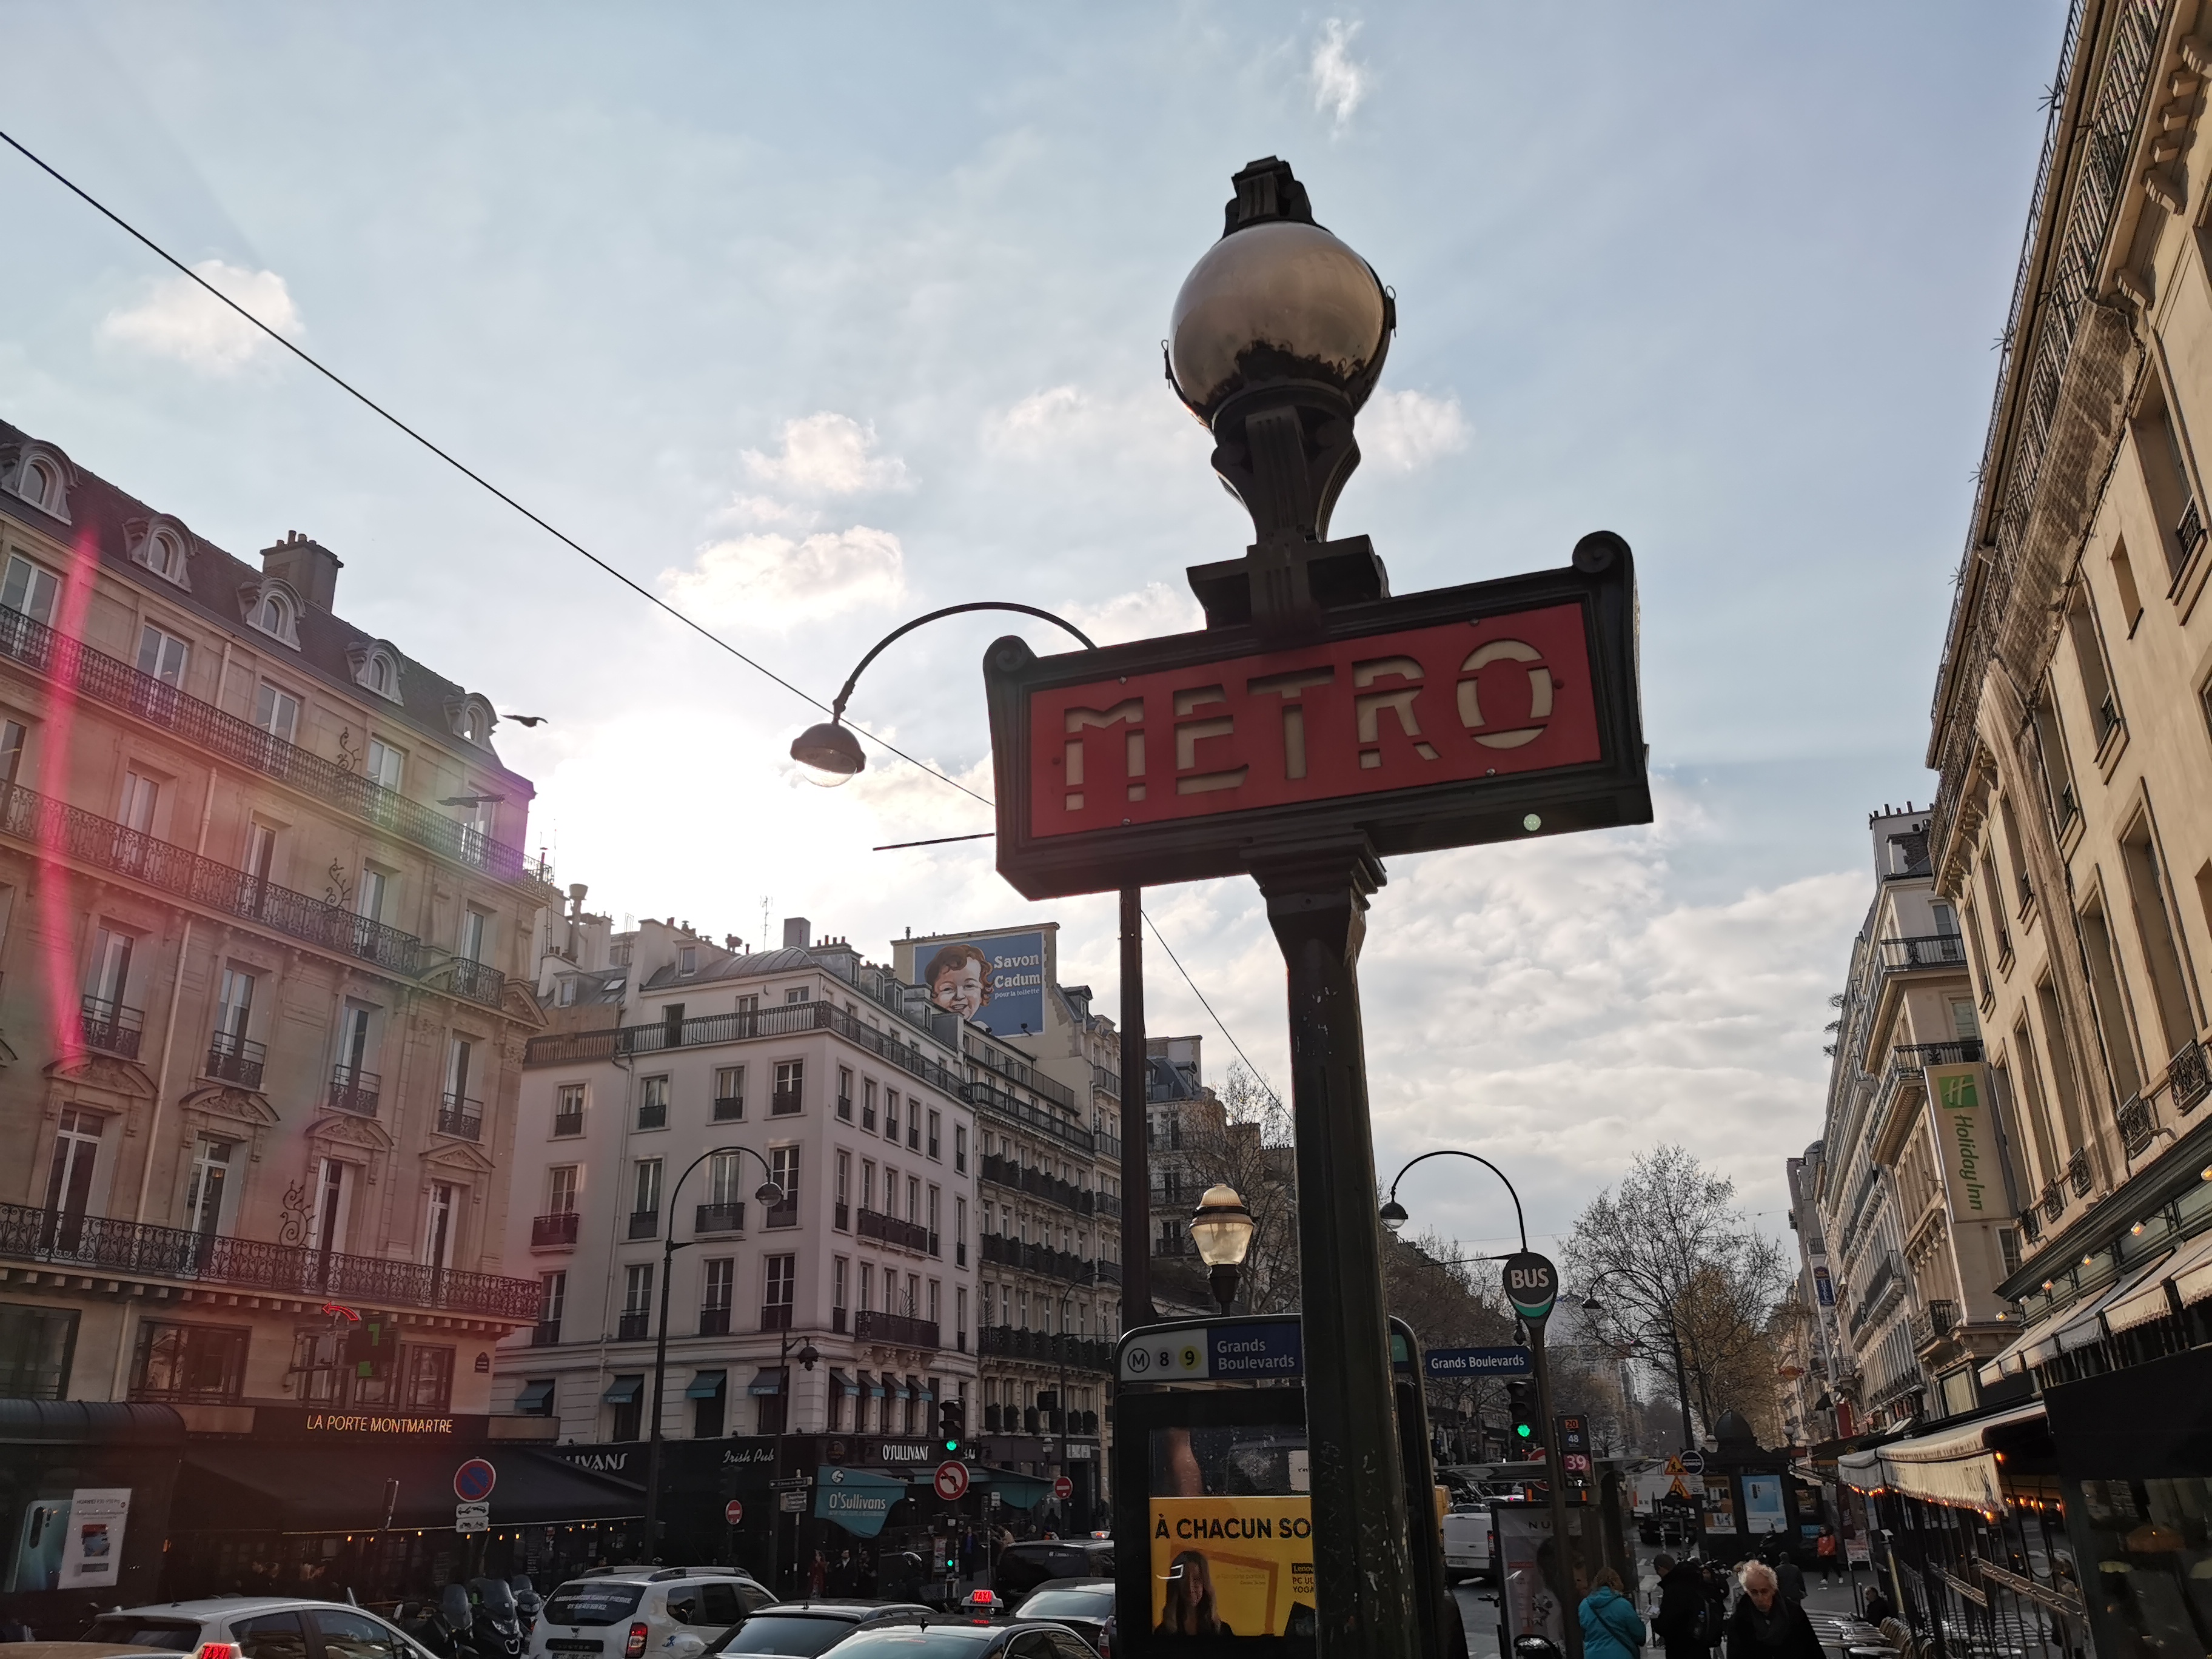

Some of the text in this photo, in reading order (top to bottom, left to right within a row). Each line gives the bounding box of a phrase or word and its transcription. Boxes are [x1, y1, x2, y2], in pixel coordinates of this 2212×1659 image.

[1064, 638, 1553, 811] METRO
[994, 954, 1039, 968] Savon
[994, 973, 1041, 988] Cadum
[994, 991, 1010, 1000] pour
[1017, 988, 1040, 996] toilette
[1953, 1114, 1985, 1210] Holiday Inn
[1510, 1268, 1549, 1289] BUS
[1217, 1338, 1266, 1353] Grands
[1159, 1352, 1169, 1367] 8
[1185, 1350, 1195, 1366] 9
[1218, 1354, 1295, 1370] Boulevards
[1431, 1355, 1525, 1369] Grands Boulevards
[307, 1414, 454, 1433] LA PORTE MONTMARTRE
[722, 1447, 774, 1463] Irish Pub
[882, 1444, 929, 1461] O'SULLIVANS
[1567, 1455, 1586, 1470] 39
[830, 1492, 886, 1509] O'Sullivans
[1155, 1513, 1311, 1539] À CHACUN SO
[974, 1591, 991, 1600] TAXI
